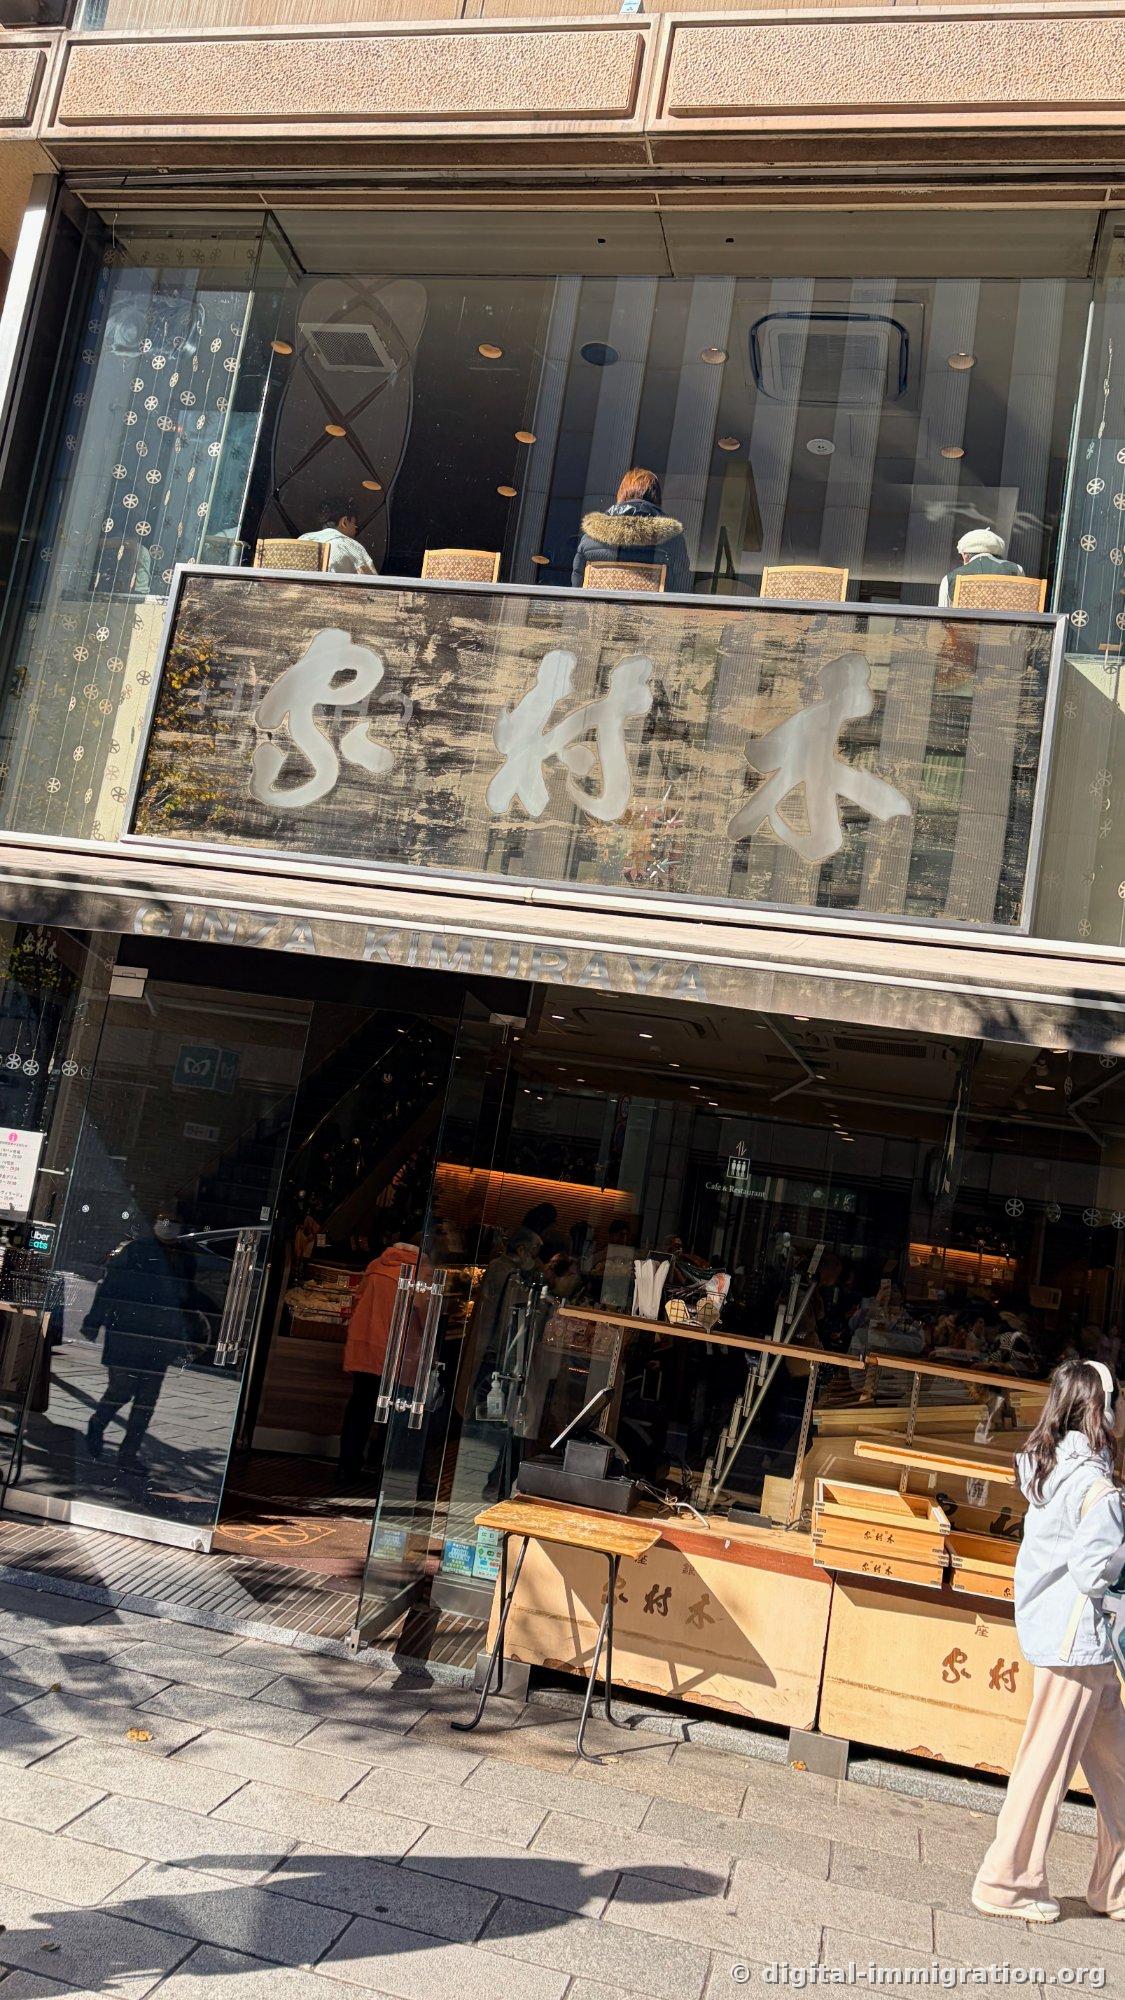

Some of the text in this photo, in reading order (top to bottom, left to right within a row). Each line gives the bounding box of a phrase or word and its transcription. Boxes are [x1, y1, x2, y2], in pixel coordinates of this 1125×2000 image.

[133, 905, 712, 1002] GINZA KIMURAYA
[705, 1181, 721, 1191] Cafe
[729, 1185, 767, 1198] Restaurant
[31, 1230, 51, 1241] Uber
[29, 1239, 48, 1250] Eats
